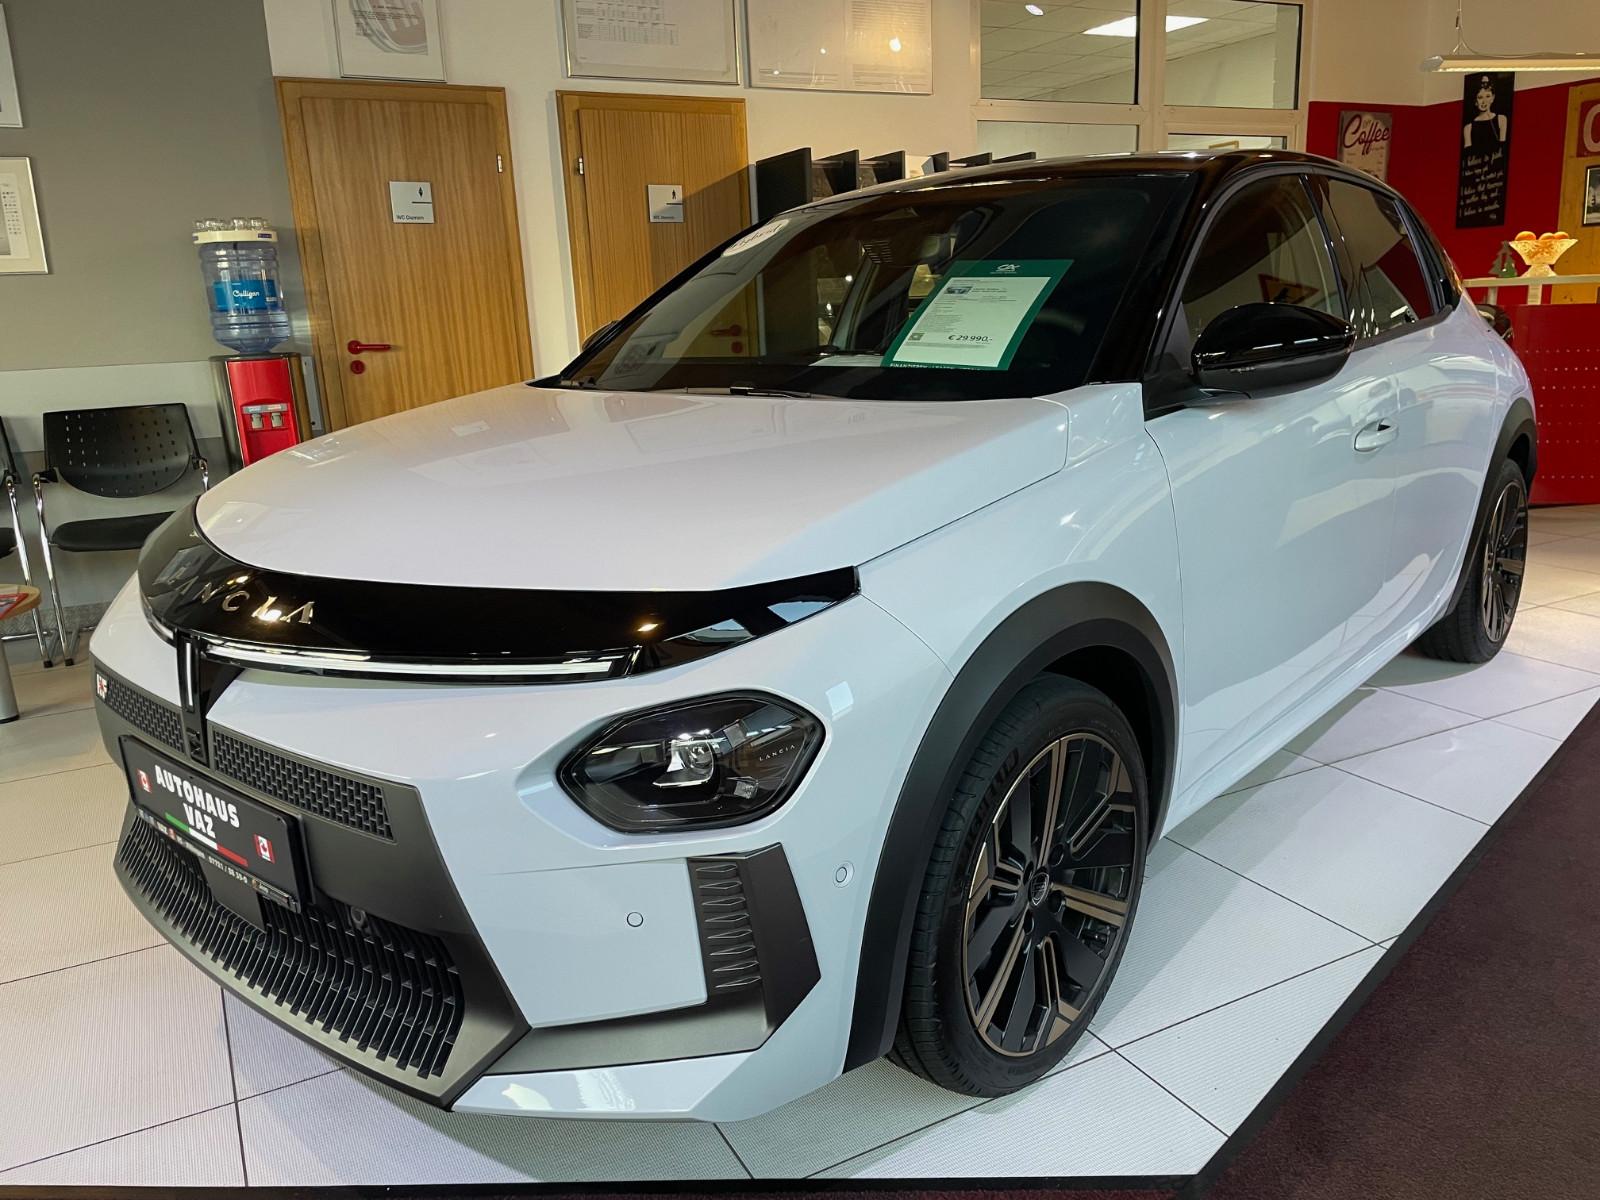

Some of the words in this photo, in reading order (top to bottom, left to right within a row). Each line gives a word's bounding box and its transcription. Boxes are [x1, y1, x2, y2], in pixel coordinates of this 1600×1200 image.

[1342, 113, 1390, 156] Coffee
[232, 289, 260, 300] Culligan
[759, 744, 796, 762] LANCIA
[154, 764, 240, 828] AUTOHAUS
[182, 802, 216, 839] VAZ
